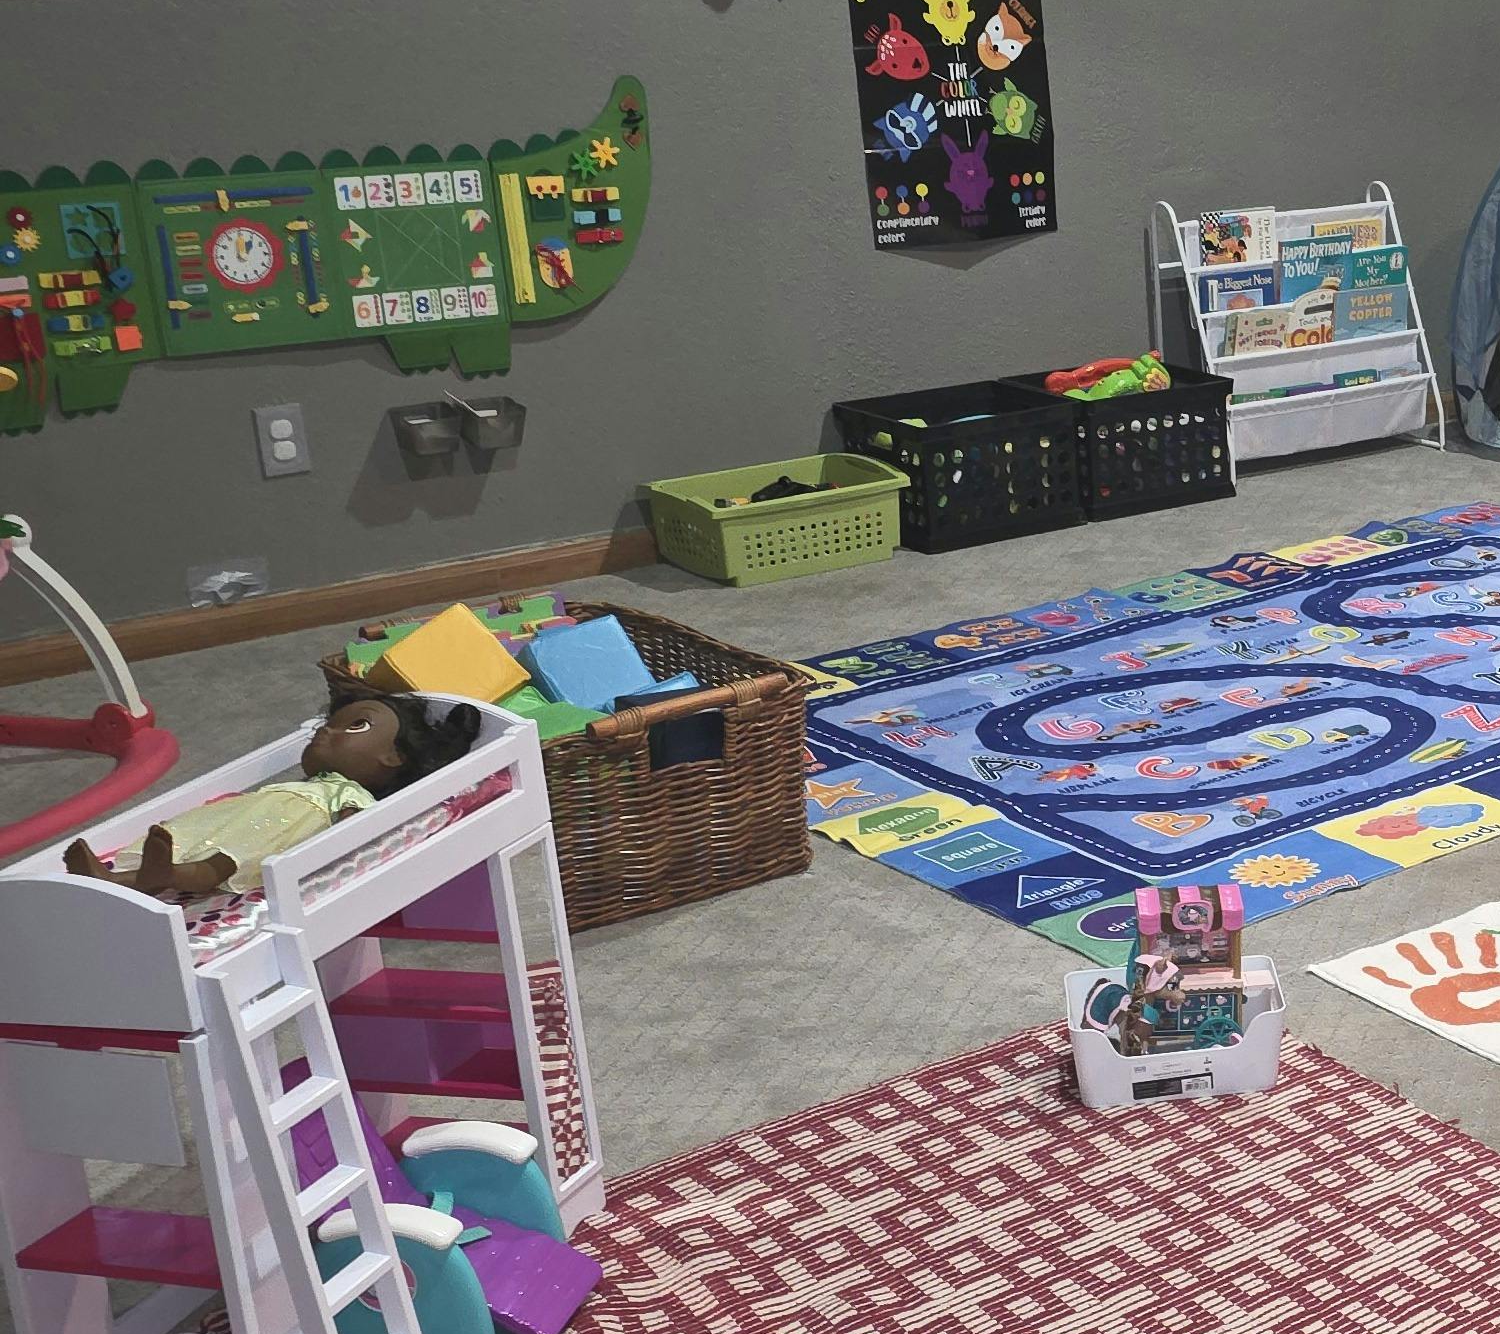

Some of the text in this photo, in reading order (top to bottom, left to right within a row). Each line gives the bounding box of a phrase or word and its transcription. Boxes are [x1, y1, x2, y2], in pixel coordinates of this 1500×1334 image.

[940, 79, 979, 99] COLOR
[338, 184, 350, 202] 1
[368, 183, 381, 201] 2
[399, 180, 412, 199] 3
[429, 179, 442, 197] 4
[459, 177, 472, 195] 5
[385, 299, 398, 317] 7
[416, 296, 430, 314] 8
[444, 294, 456, 312] 9
[472, 291, 487, 308] 10
[356, 301, 371, 319] 6
